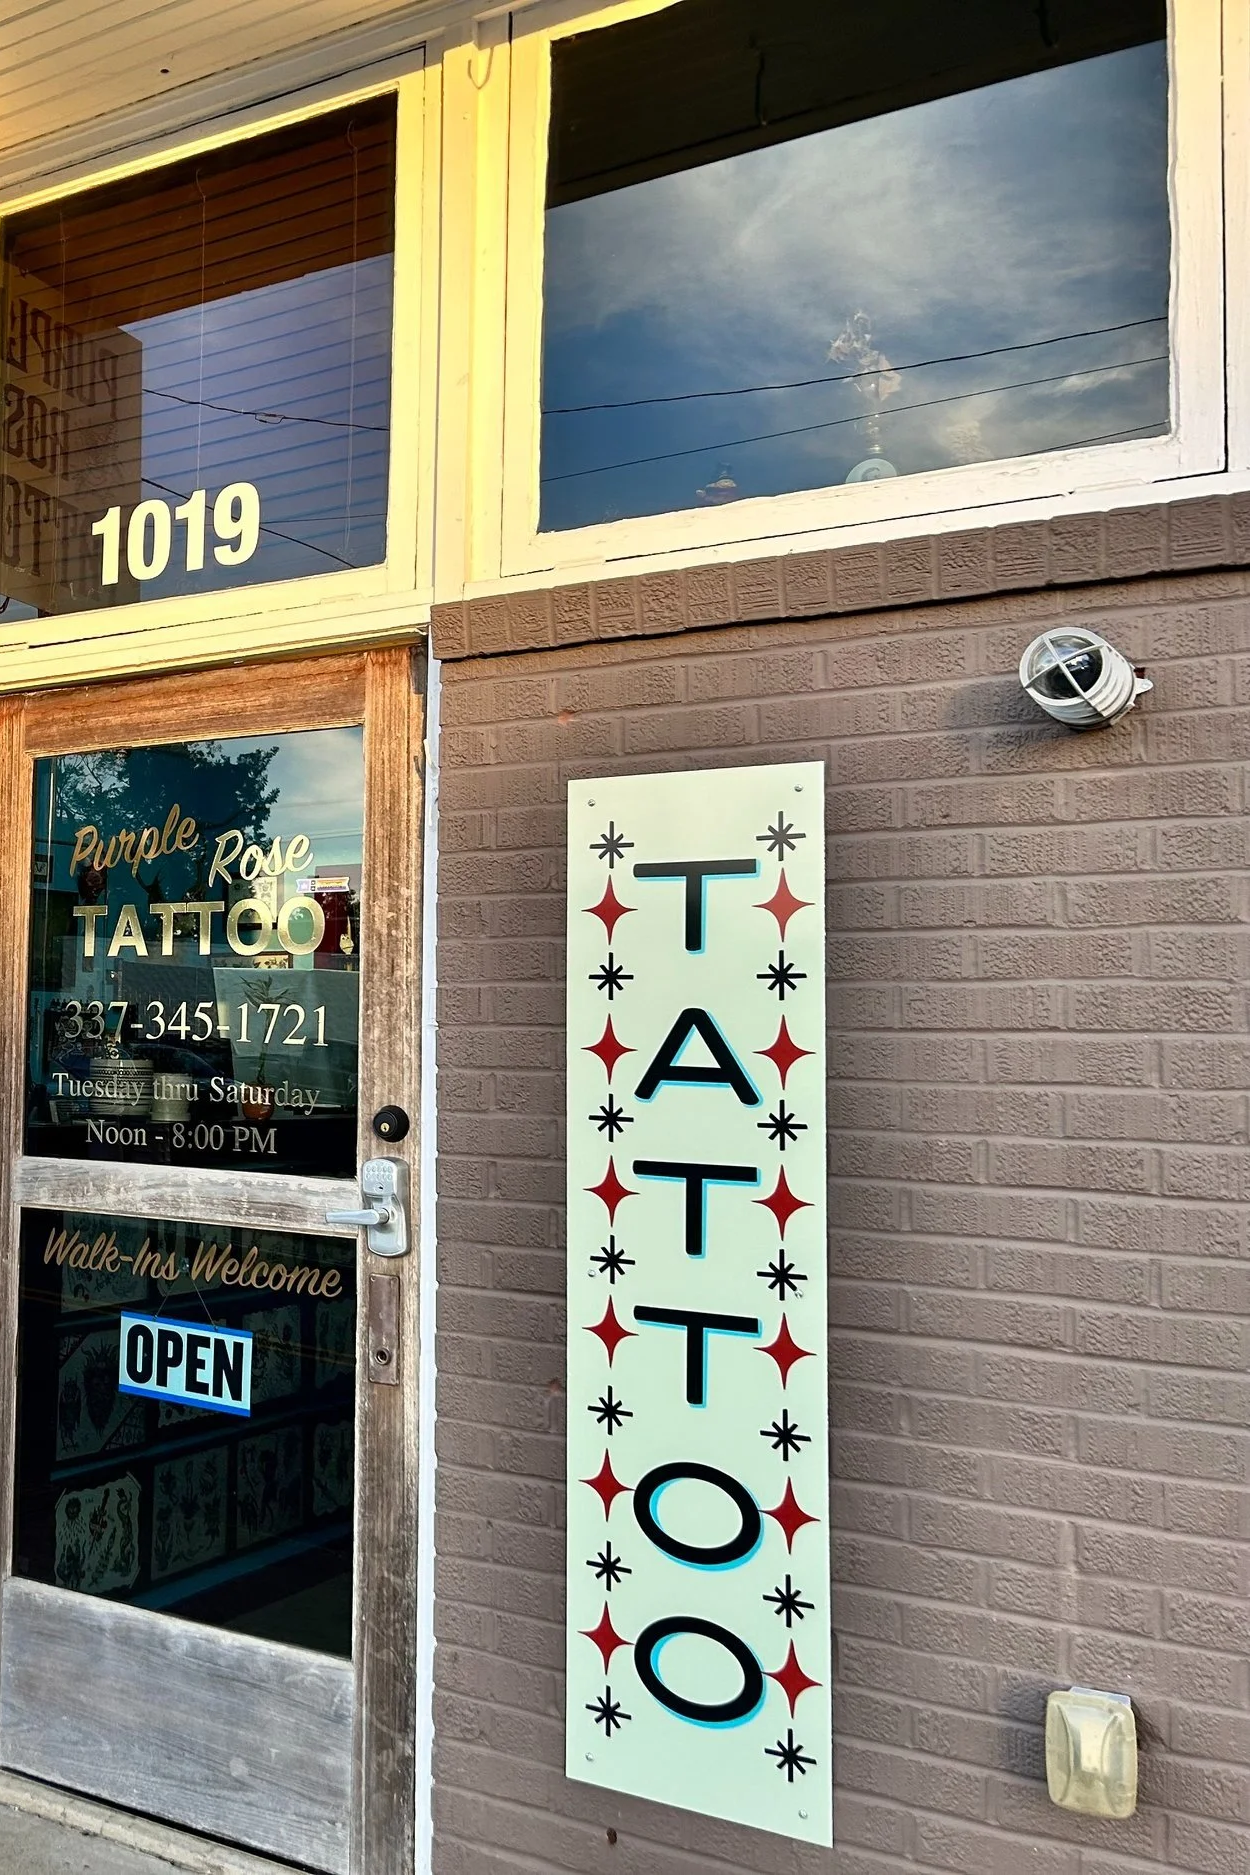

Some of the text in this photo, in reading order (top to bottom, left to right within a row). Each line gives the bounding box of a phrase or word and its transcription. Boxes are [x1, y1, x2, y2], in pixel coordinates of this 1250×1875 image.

[91, 481, 261, 587] 1019
[69, 803, 314, 888] Purple Rose
[72, 897, 327, 958] TATTOO
[63, 1000, 329, 1048] 337-345-1721
[52, 1072, 321, 1116] Tuesday thru Saturday
[85, 1118, 148, 1146] Noon
[171, 1122, 225, 1152] 8:00
[232, 1126, 279, 1155] PM
[43, 1227, 343, 1298] Walk-Ins Welcome
[632, 857, 767, 1731] TATTOO
[125, 1323, 245, 1403] OPEN
